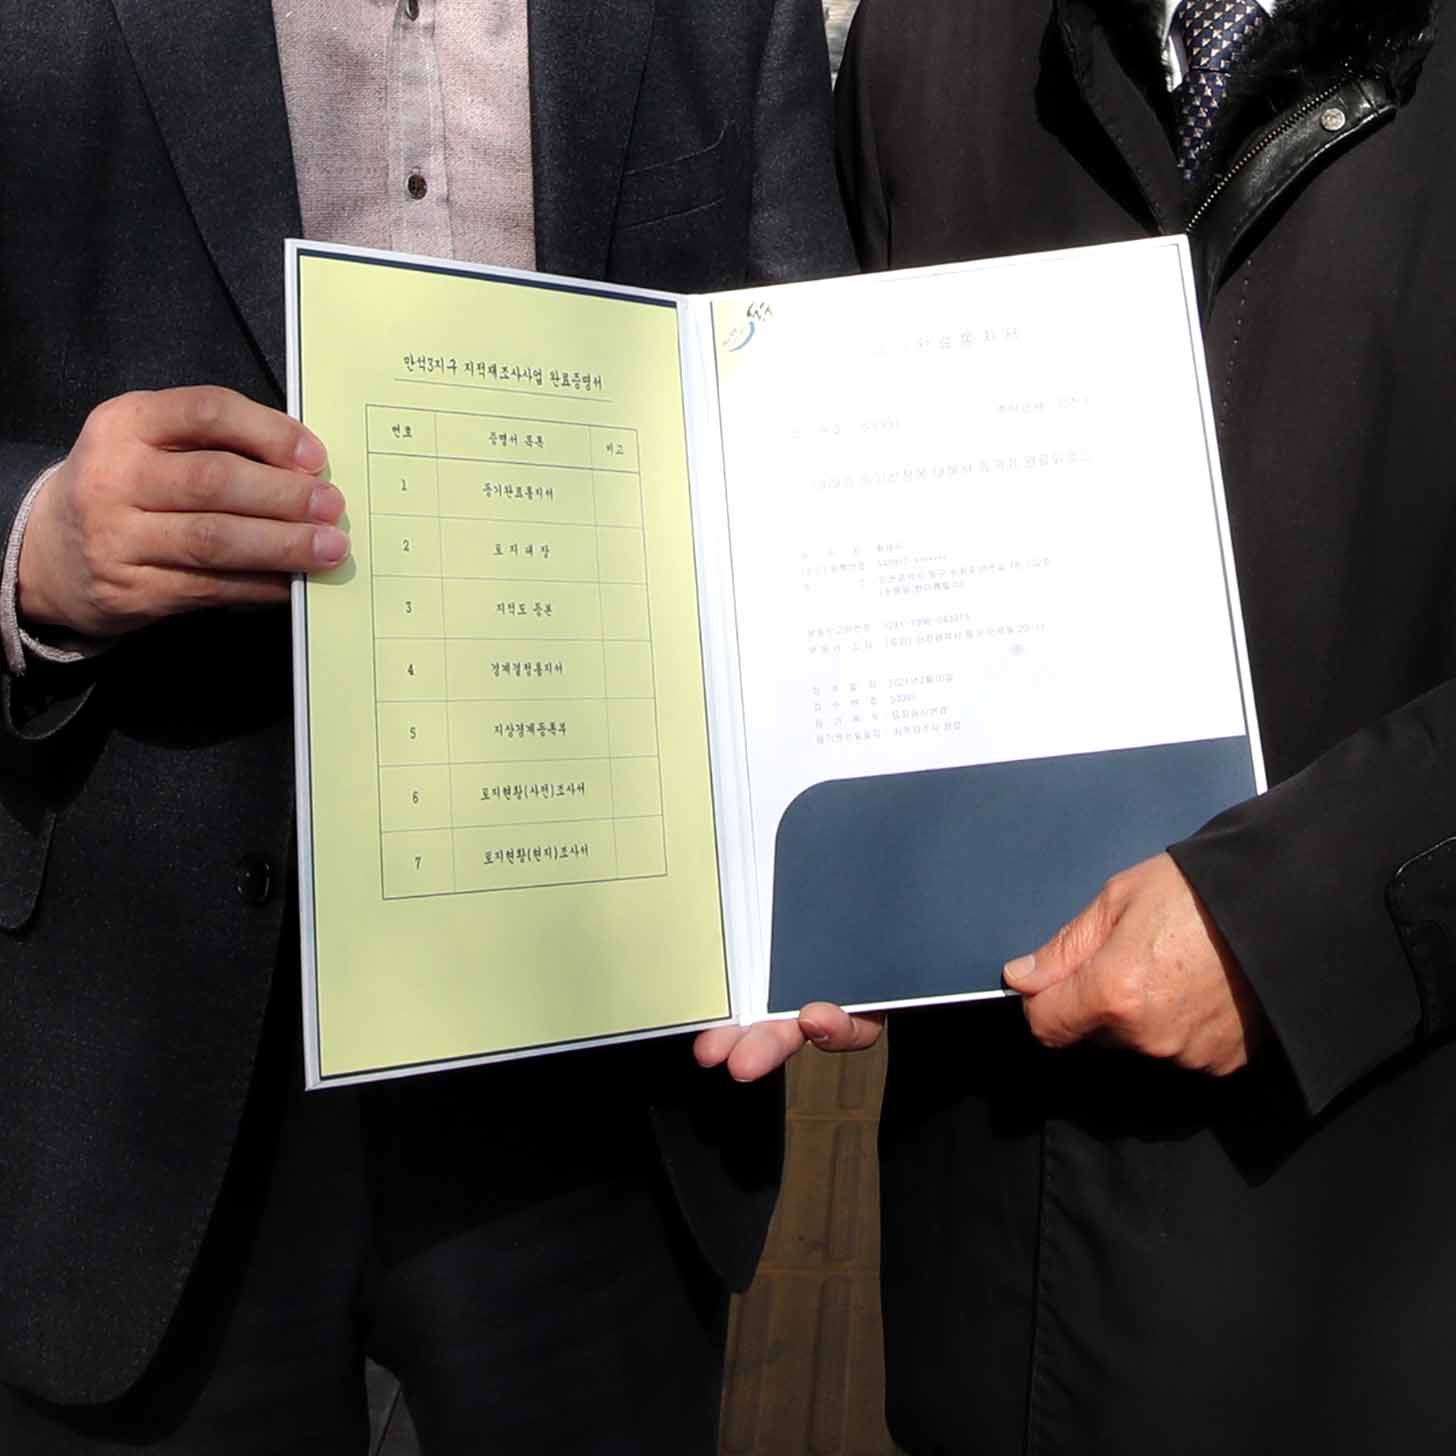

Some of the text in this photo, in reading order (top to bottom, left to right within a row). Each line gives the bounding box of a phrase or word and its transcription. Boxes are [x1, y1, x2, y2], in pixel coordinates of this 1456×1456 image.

[401, 479, 407, 491] 1
[403, 539, 409, 552] 2
[406, 601, 411, 613] 3
[408, 664, 413, 675] 4
[410, 727, 416, 739] 5
[413, 791, 419, 804] 6
[415, 857, 421, 870] 7
